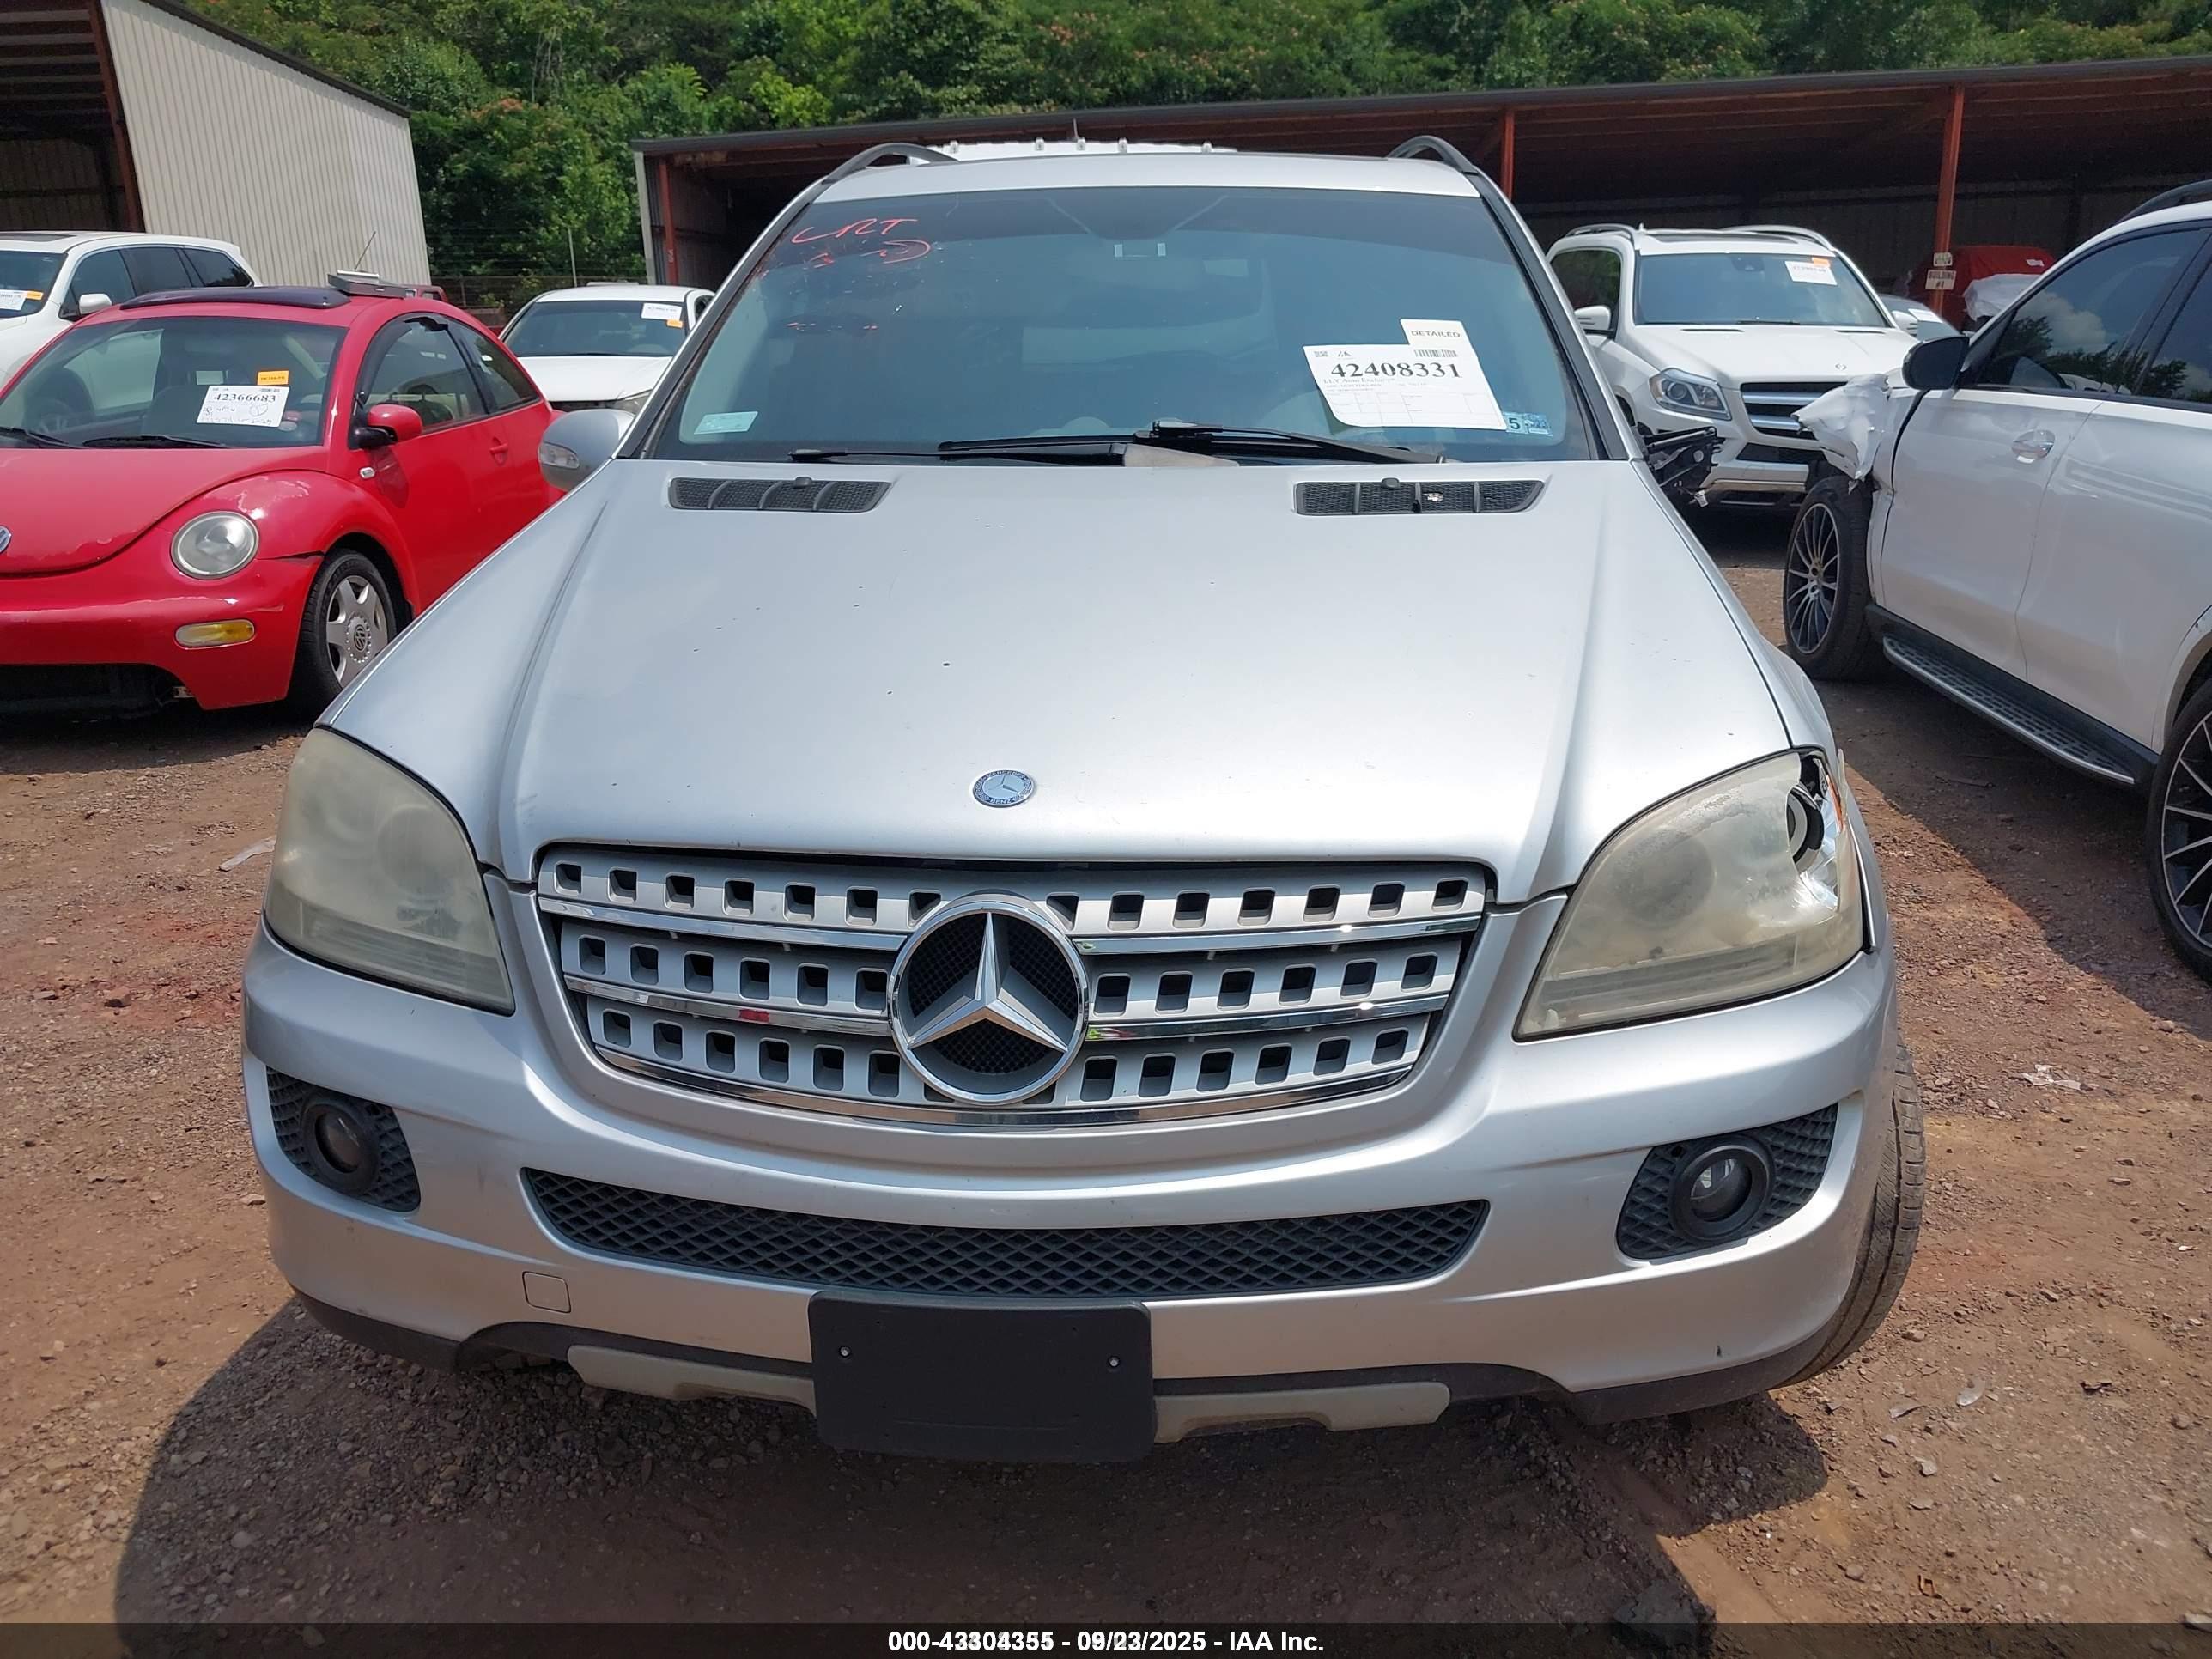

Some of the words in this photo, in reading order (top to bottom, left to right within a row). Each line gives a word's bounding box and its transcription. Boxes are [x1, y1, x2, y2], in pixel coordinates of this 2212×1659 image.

[1331, 362, 1463, 379] 42408331
[214, 393, 276, 403] 42366683
[1509, 417, 1521, 430] 5
